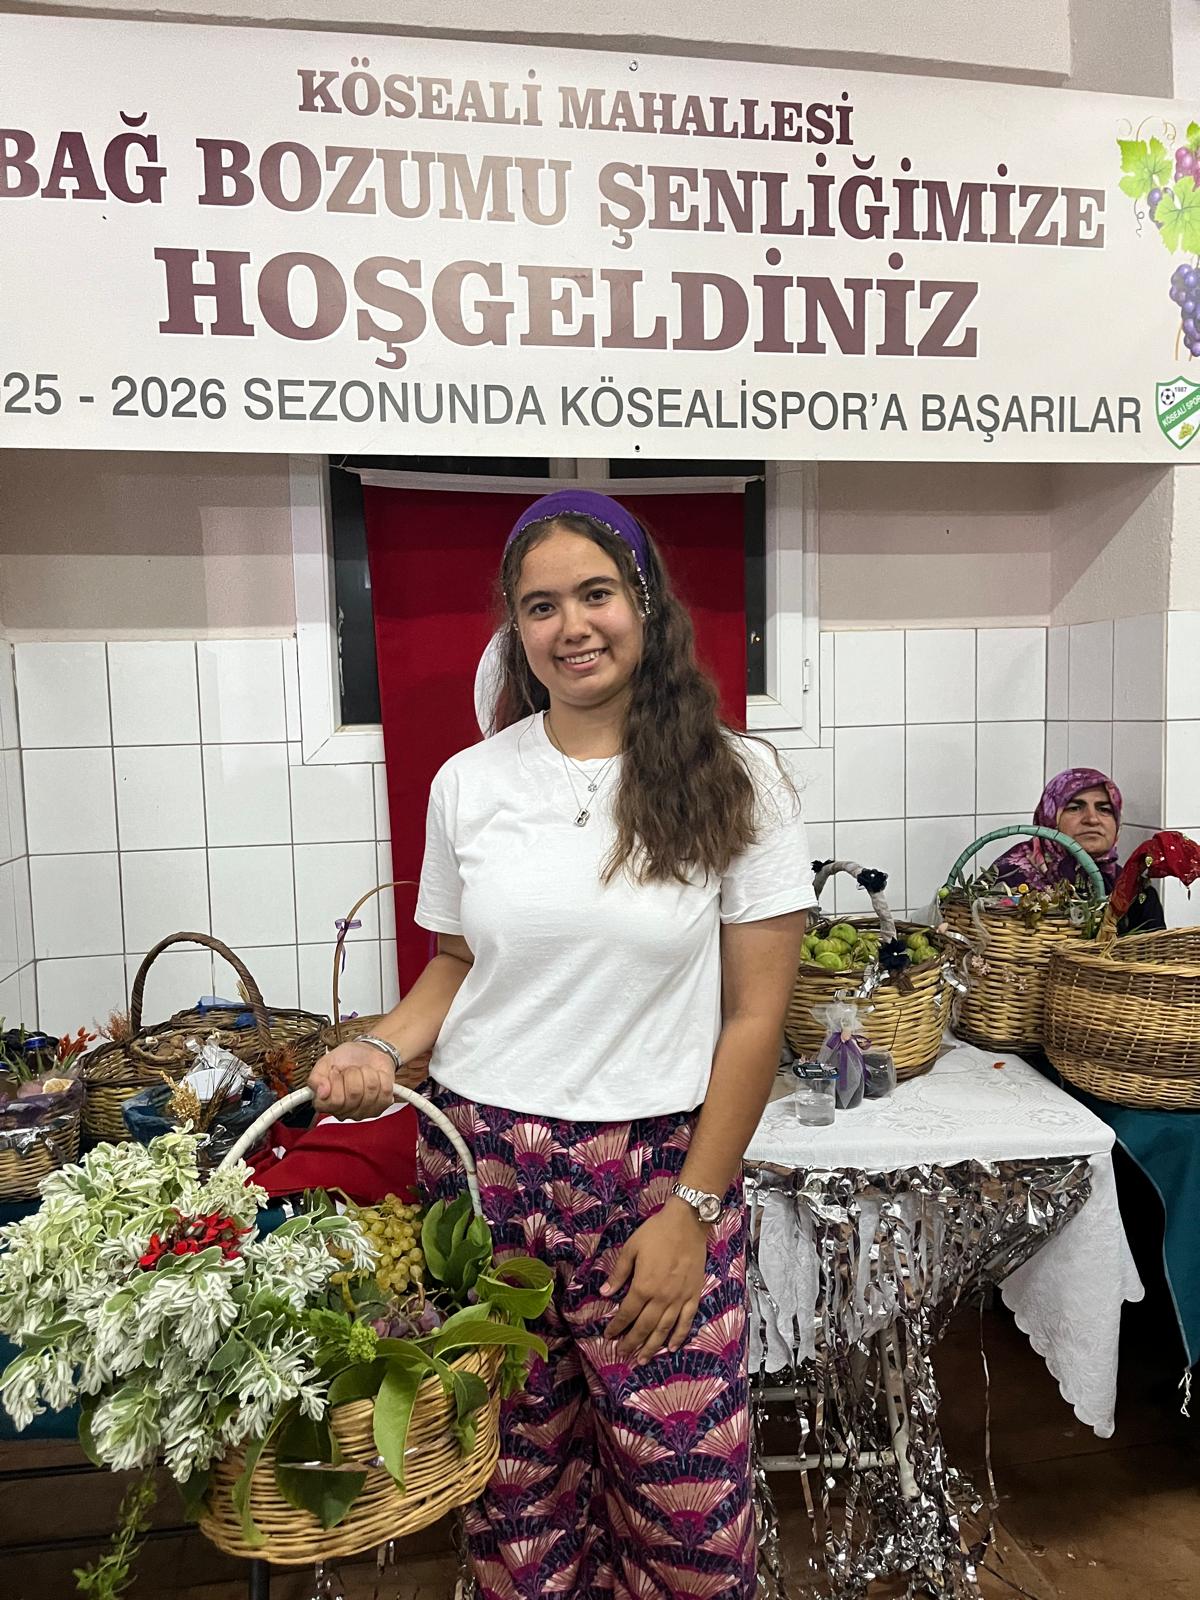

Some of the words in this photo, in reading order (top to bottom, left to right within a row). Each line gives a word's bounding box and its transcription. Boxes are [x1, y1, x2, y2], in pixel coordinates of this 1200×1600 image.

[297, 57, 542, 126] KÖSEALİ
[559, 87, 853, 145] MAHALLESİ
[0, 111, 167, 203] BAĞ
[196, 138, 571, 226] BOZUMU
[599, 152, 1105, 249] ŞENLİĞİMİZE
[154, 247, 978, 369] HOŞGELDİNİZ
[0, 372, 61, 416] 25
[112, 376, 226, 420] 2026
[244, 378, 546, 427] SEZONUNDA
[922, 394, 1141, 442] BAŞARILAR
